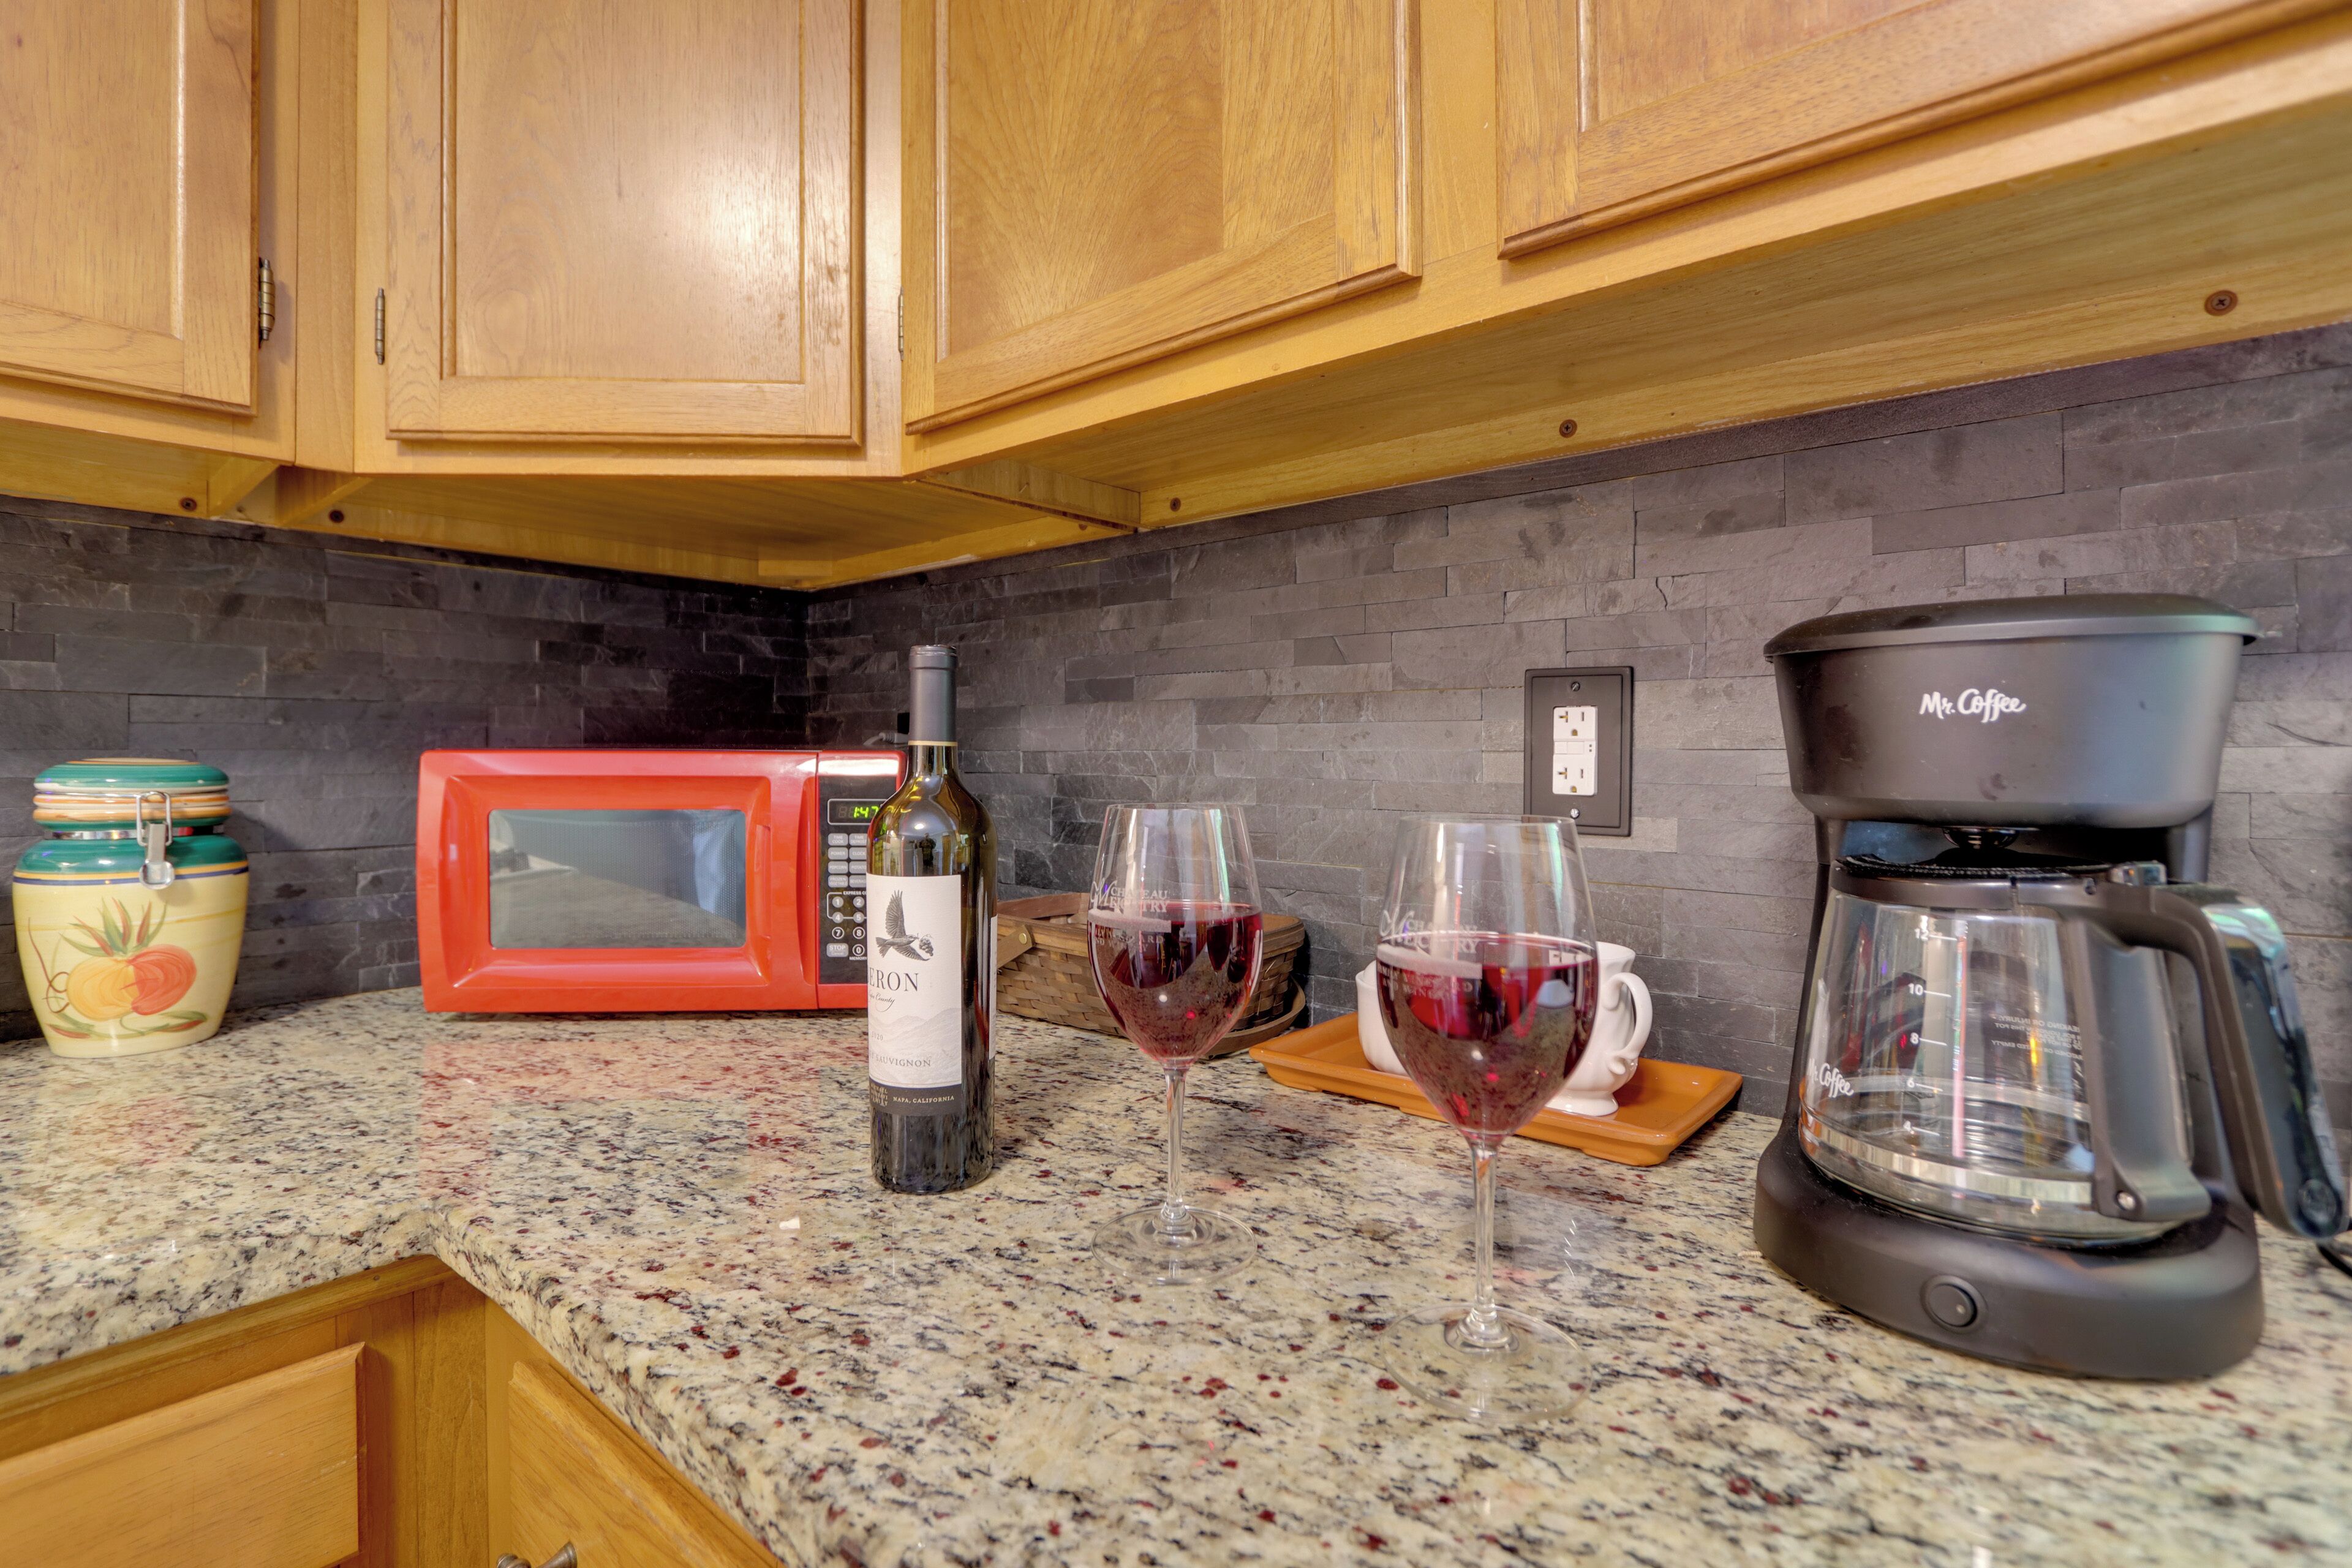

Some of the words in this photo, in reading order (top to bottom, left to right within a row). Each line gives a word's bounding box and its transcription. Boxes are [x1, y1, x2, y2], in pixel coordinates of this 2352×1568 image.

[1919, 692, 1956, 719] Mr.
[1957, 688, 2027, 723] Coffee
[1915, 928, 1929, 941] 12
[869, 967, 919, 992] ERON
[1908, 982, 1924, 995] 10
[875, 992, 895, 1012] County
[1910, 1032, 1920, 1045] 8
[876, 1055, 930, 1068] SAUVIGNON
[1819, 1062, 1854, 1098] Coffee
[1906, 1077, 1915, 1088] 6
